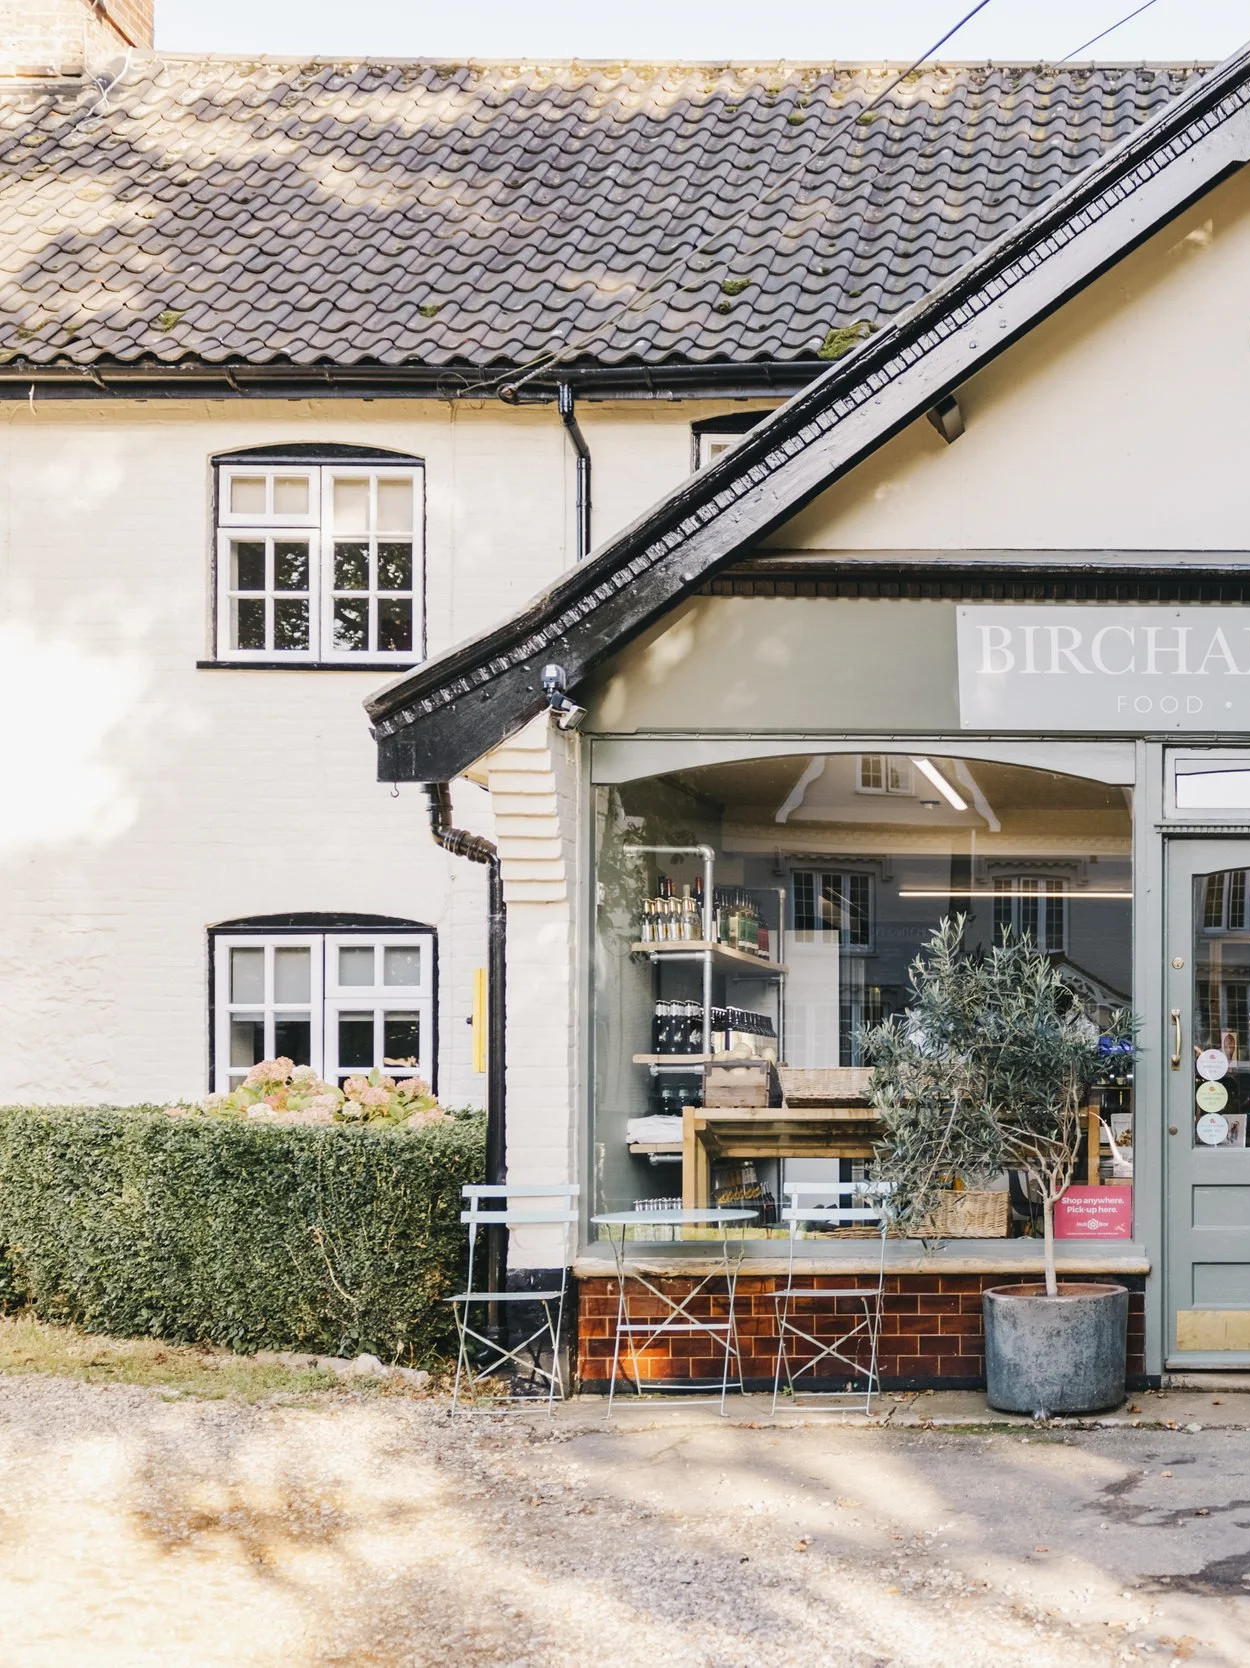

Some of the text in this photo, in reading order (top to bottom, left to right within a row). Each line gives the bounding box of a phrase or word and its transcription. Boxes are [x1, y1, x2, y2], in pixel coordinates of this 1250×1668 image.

[1117, 694, 1204, 715] FOOD
[1061, 1196, 1125, 1205] Shop anywhere.
[1067, 1206, 1097, 1214] Pick-up
